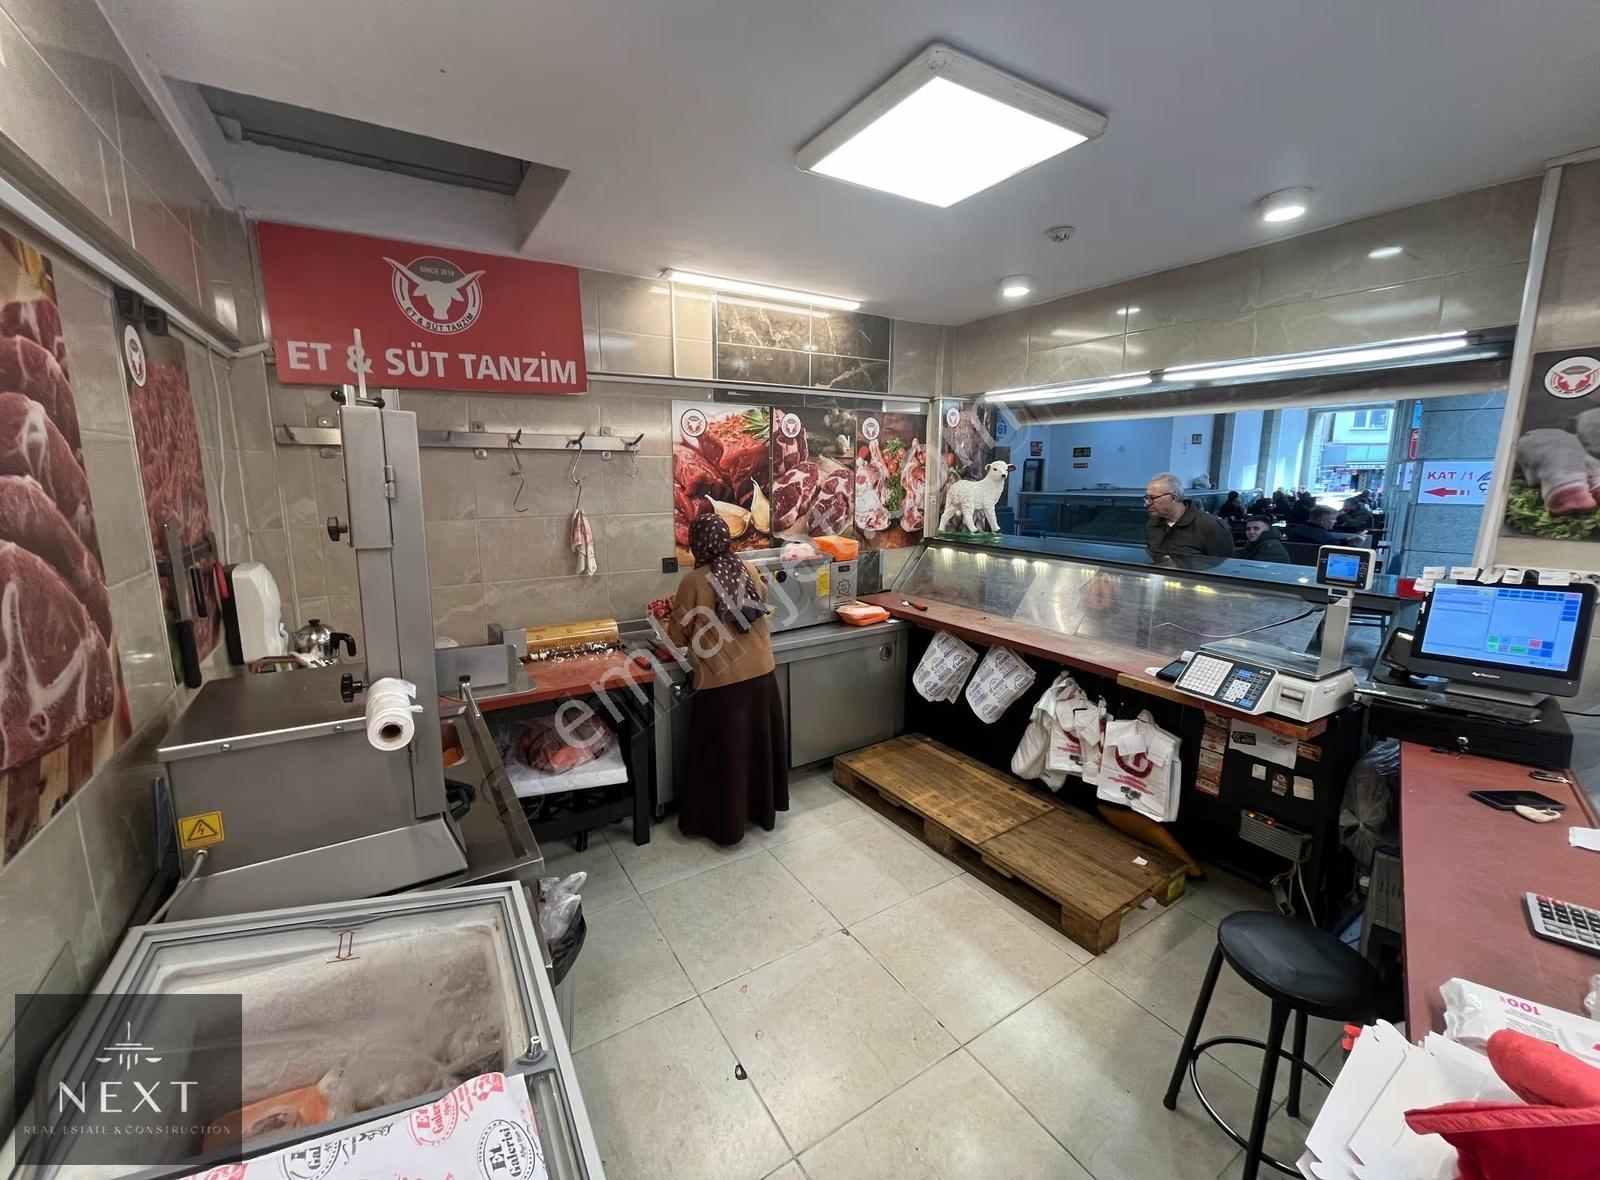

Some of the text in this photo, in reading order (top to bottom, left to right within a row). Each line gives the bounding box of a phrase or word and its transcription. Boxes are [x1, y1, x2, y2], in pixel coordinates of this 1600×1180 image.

[405, 306, 418, 318] ET
[287, 341, 577, 384] ET & SÜT TANZİM
[1427, 471, 1457, 480] KAT
